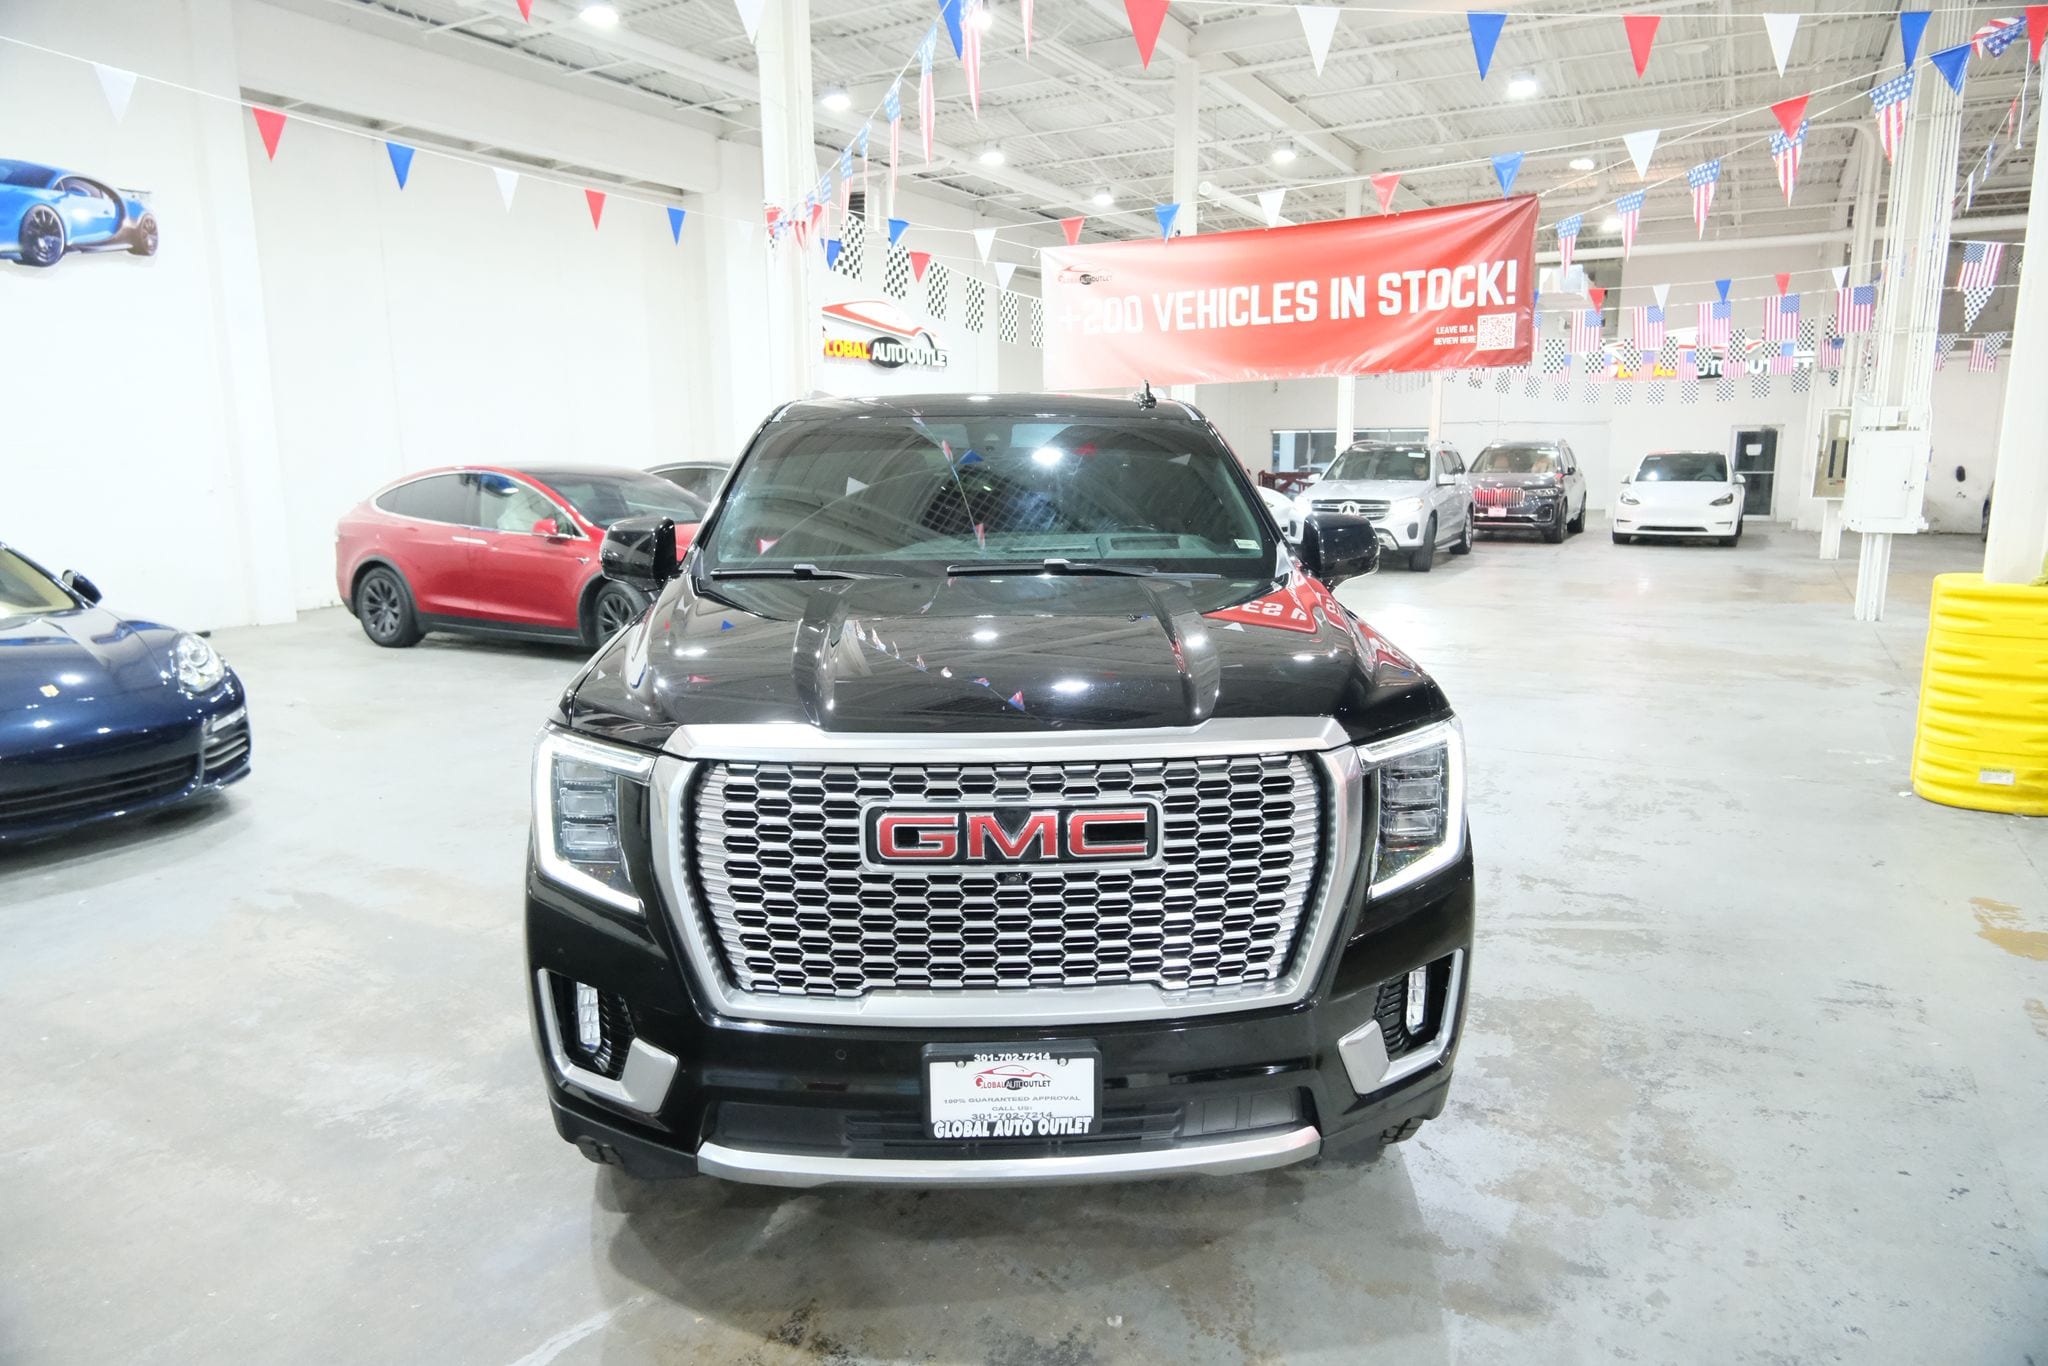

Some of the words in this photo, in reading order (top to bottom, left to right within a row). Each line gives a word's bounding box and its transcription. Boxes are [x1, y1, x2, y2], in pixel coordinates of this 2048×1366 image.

[1152, 280, 1319, 332] VEHICLES
[1330, 275, 1366, 320] IN
[1378, 259, 1518, 316] STOCK!
[1435, 325, 1459, 335] LEAVE
[1459, 325, 1469, 333] US
[1469, 324, 1475, 333] A
[1433, 336, 1459, 346] REVIEW
[1460, 335, 1477, 344] HERE
[823, 338, 870, 361] LOBAL
[872, 341, 907, 363] AUTO
[875, 808, 1148, 860] GMC
[973, 1051, 1051, 1062] 301-702-7214
[1023, 1080, 1051, 1088] OUTLET
[968, 1096, 1029, 1104] GUARANTEED
[971, 1111, 1053, 1121] 301-702-7214
[933, 1119, 990, 1139] GLOBAL
[993, 1118, 1034, 1137] AUTO
[1037, 1116, 1092, 1136] OUTLET
